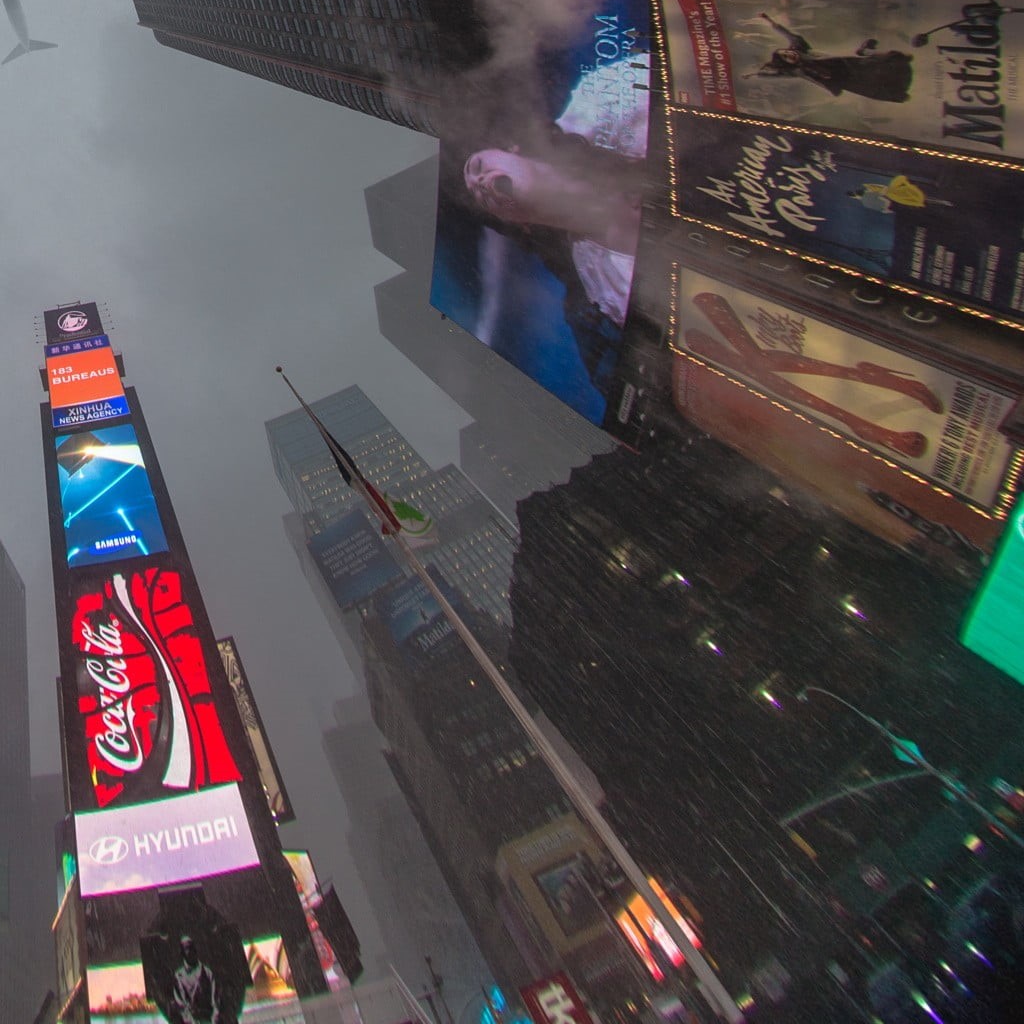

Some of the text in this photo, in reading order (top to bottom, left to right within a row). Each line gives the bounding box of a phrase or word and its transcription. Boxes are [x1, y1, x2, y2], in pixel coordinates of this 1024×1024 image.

[688, 10, 717, 96] TIME Magazine's
[699, 0, 732, 104] #1 Show of the Year!
[594, 15, 620, 150] PHANTOM
[695, 175, 740, 208] An
[727, 134, 791, 239] American
[774, 164, 825, 232] Paris
[51, 366, 72, 375] 183
[52, 366, 113, 385] BUREAUS
[59, 407, 122, 423] NEWS AGENCY
[68, 401, 112, 415] XINHUA
[948, 380, 975, 421] AWARDS
[968, 389, 990, 432] MUSICAL
[943, 415, 964, 443] TONY
[962, 427, 977, 454] BEST
[94, 535, 136, 549] SAMSUNG
[416, 617, 456, 651] Matild
[80, 621, 142, 770] Coca-Cola
[132, 815, 238, 856] HYUNDAI
